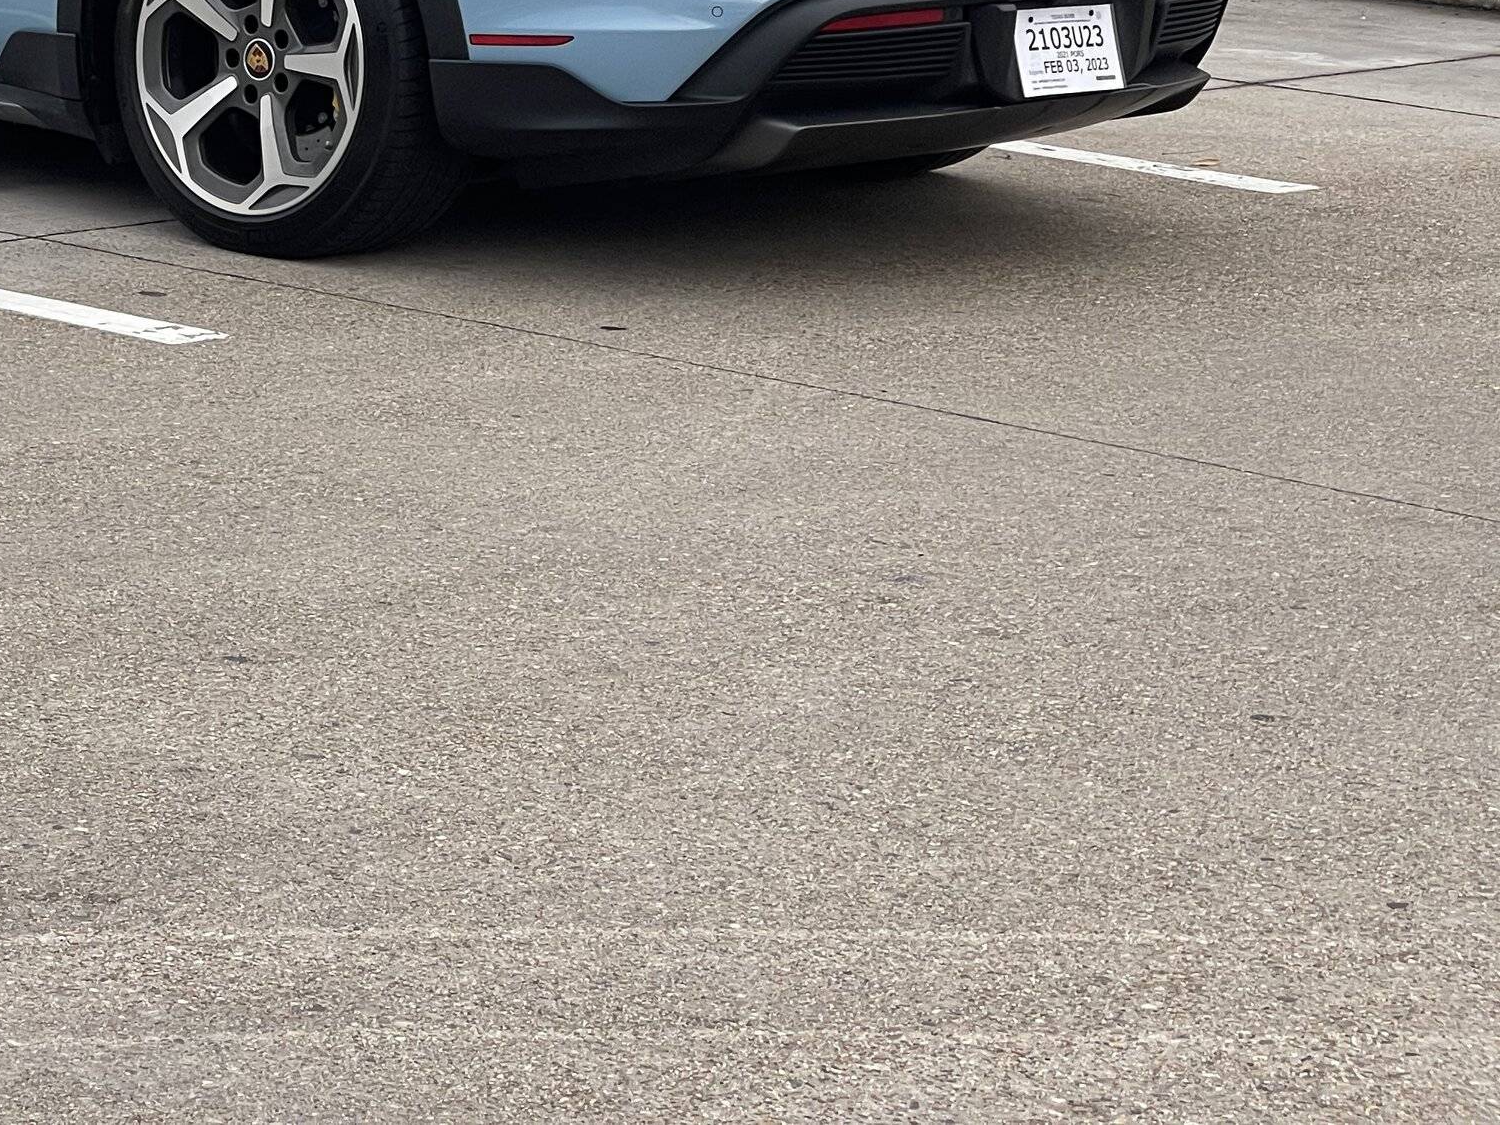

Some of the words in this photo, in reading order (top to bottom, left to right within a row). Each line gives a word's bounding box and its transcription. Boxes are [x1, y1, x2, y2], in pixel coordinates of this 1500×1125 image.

[1025, 24, 1104, 51] 2103U23
[1043, 59, 1064, 74] FEB
[1066, 58, 1084, 74] 03,
[1085, 56, 1110, 72] 2023
